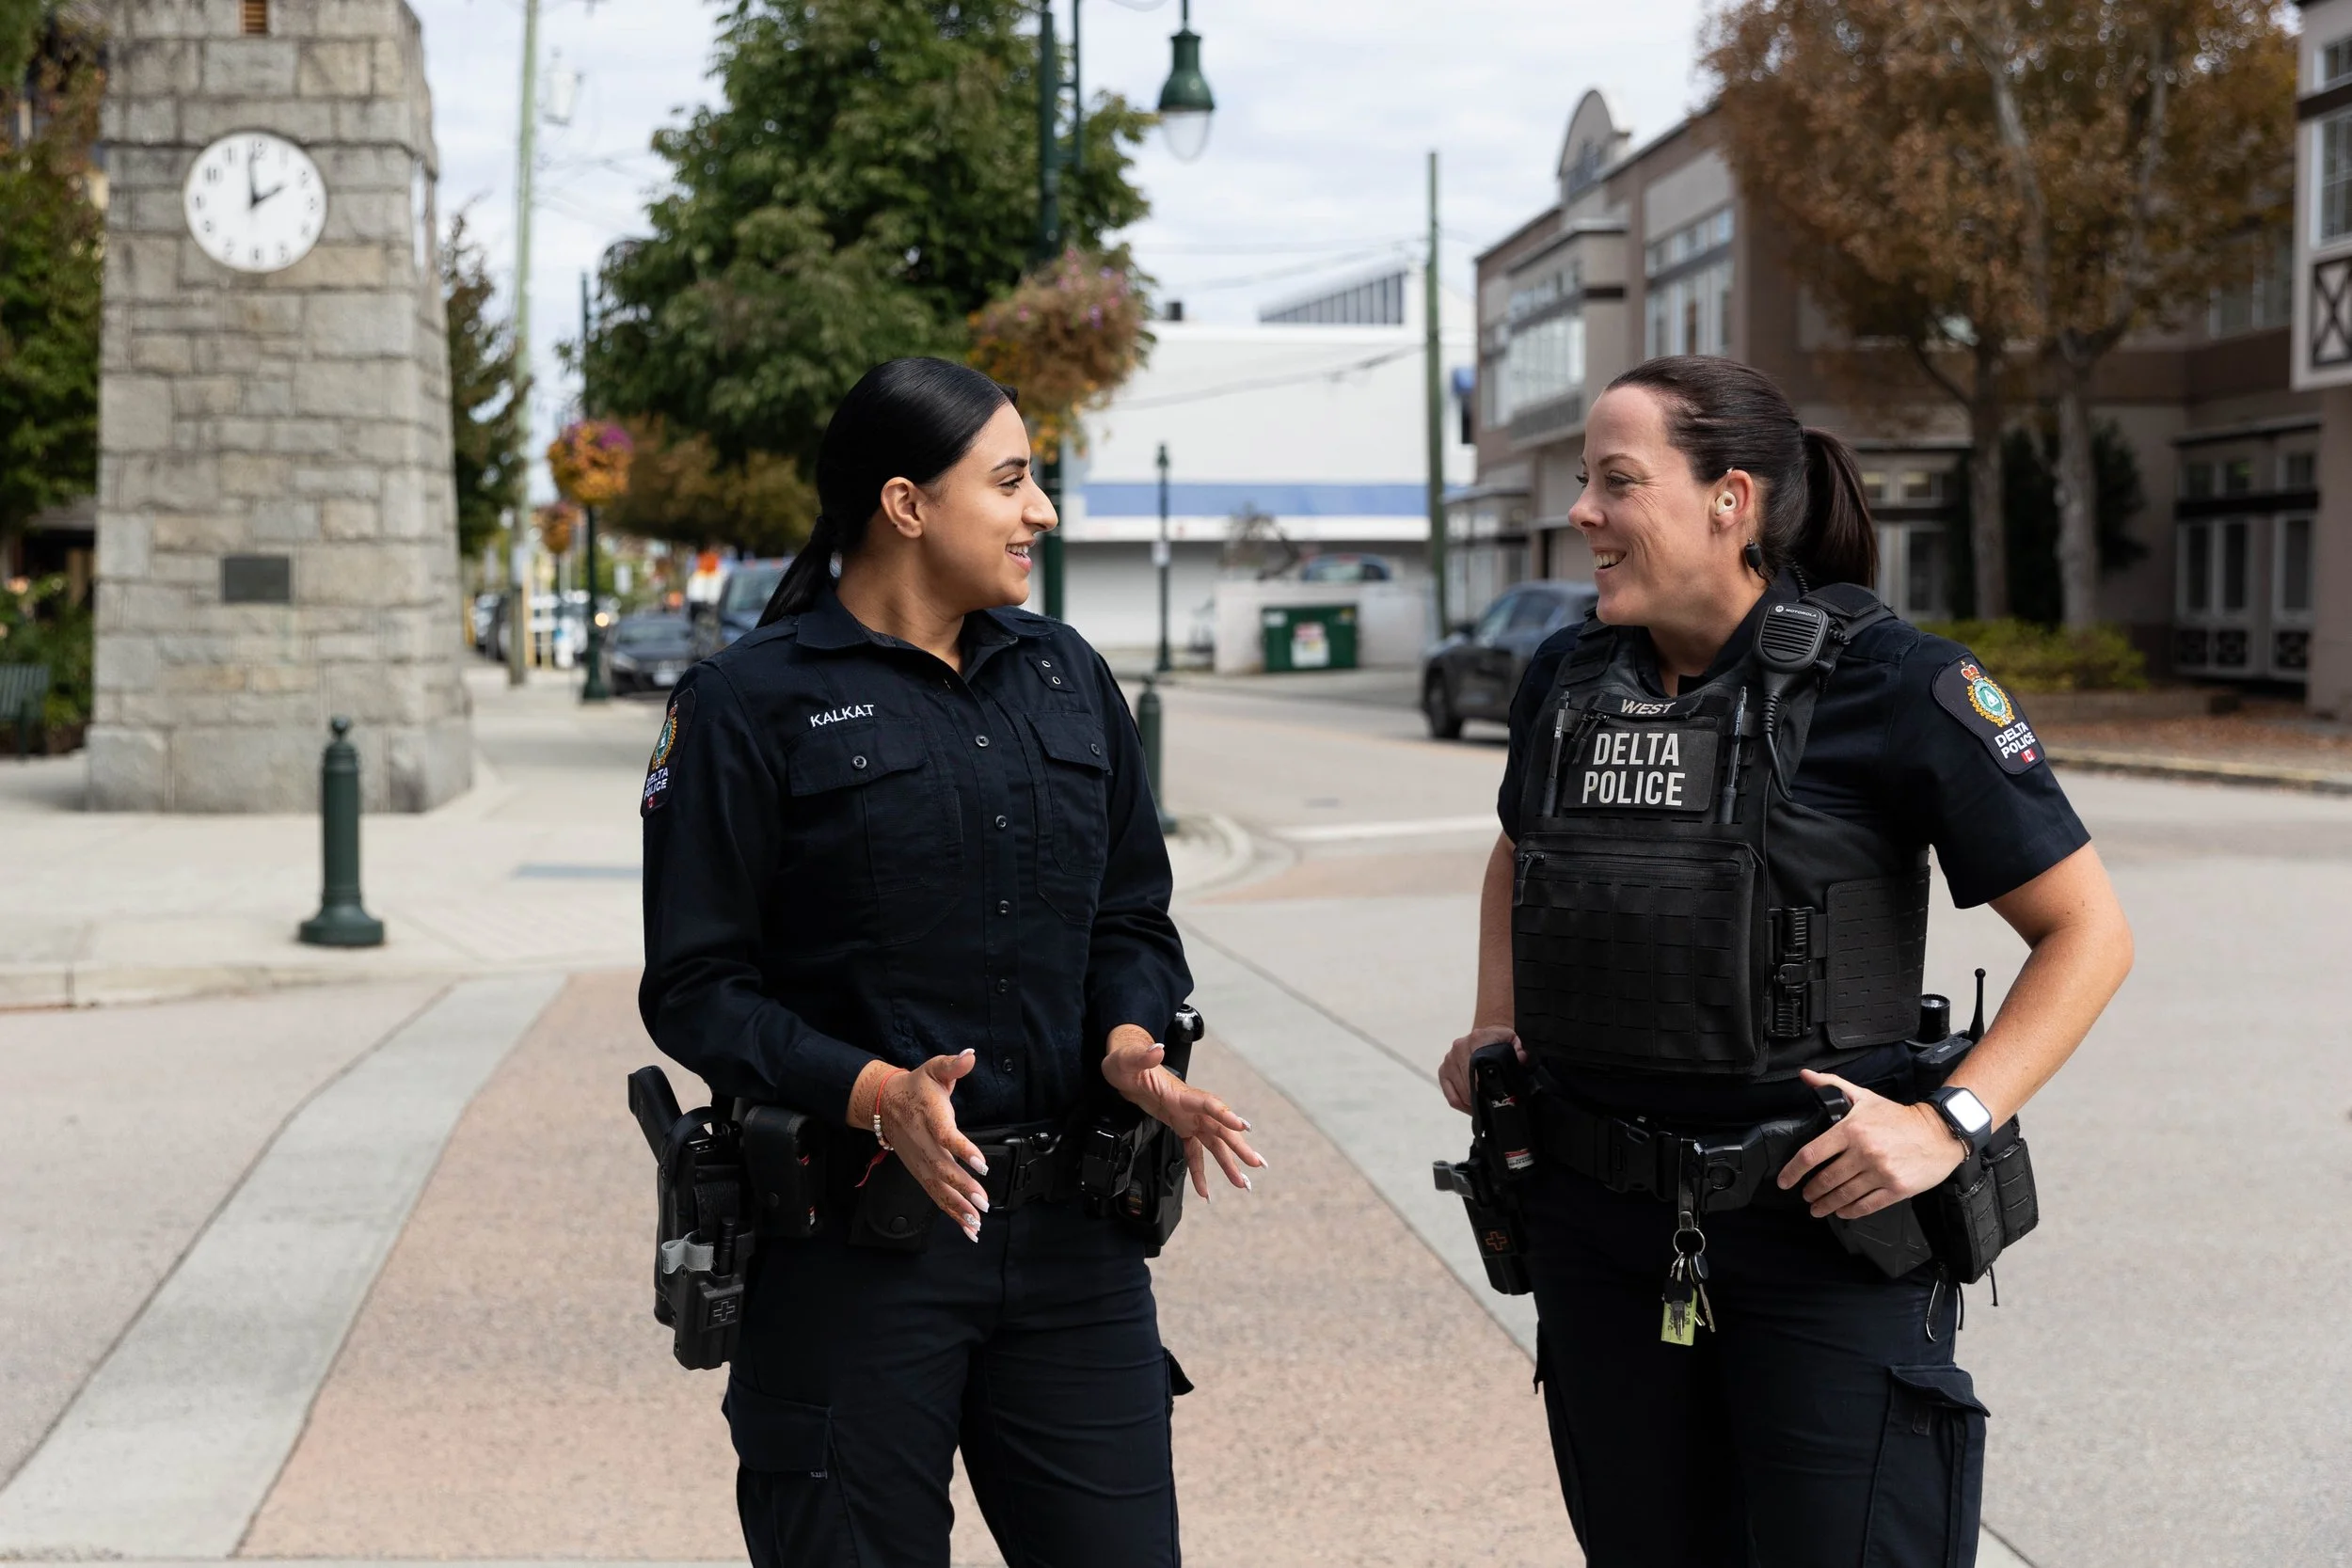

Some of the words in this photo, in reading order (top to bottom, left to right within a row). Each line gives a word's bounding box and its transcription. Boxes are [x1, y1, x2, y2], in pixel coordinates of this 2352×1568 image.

[1785, 609, 1817, 617] MOTOROLA
[810, 704, 874, 727] KALKAT
[1620, 698, 1677, 715] WEST
[1994, 721, 2029, 748] DELTA
[2000, 731, 2036, 759] POLICE
[1592, 733, 1679, 766] DELTA
[1581, 770, 1686, 806] POLICE
